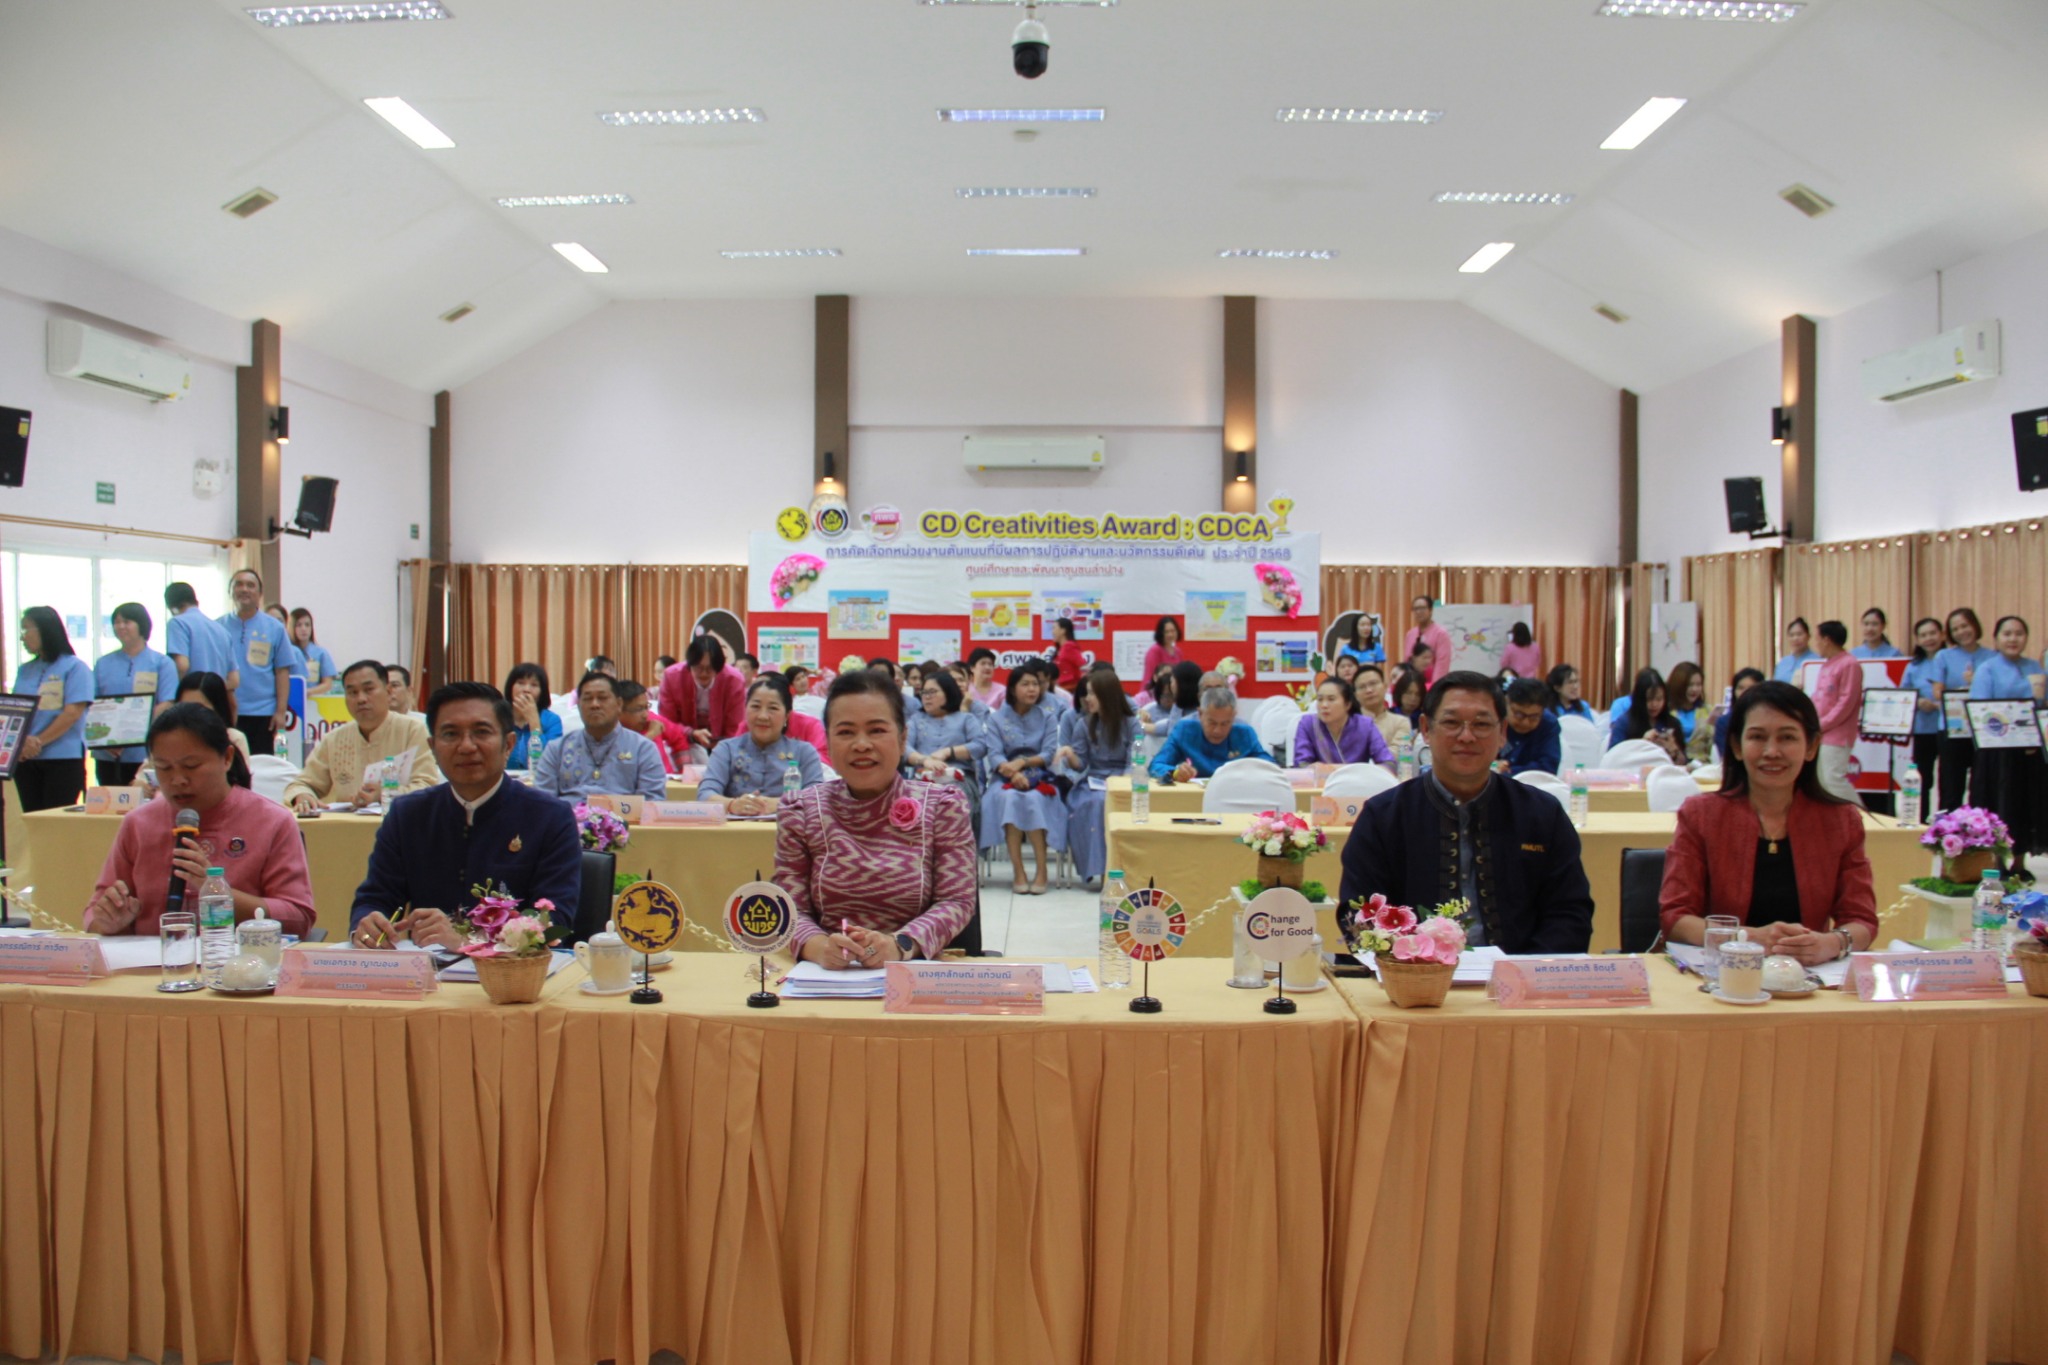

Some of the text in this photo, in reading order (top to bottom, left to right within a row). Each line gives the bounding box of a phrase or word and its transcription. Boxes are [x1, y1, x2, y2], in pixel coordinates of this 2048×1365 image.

[922, 513, 958, 534] CD
[964, 514, 1095, 536] Creativities
[1102, 516, 1177, 538] Award
[1198, 517, 1270, 538] CDCA
[1260, 549, 1292, 561] 2568
[1271, 927, 1313, 936] for Good
